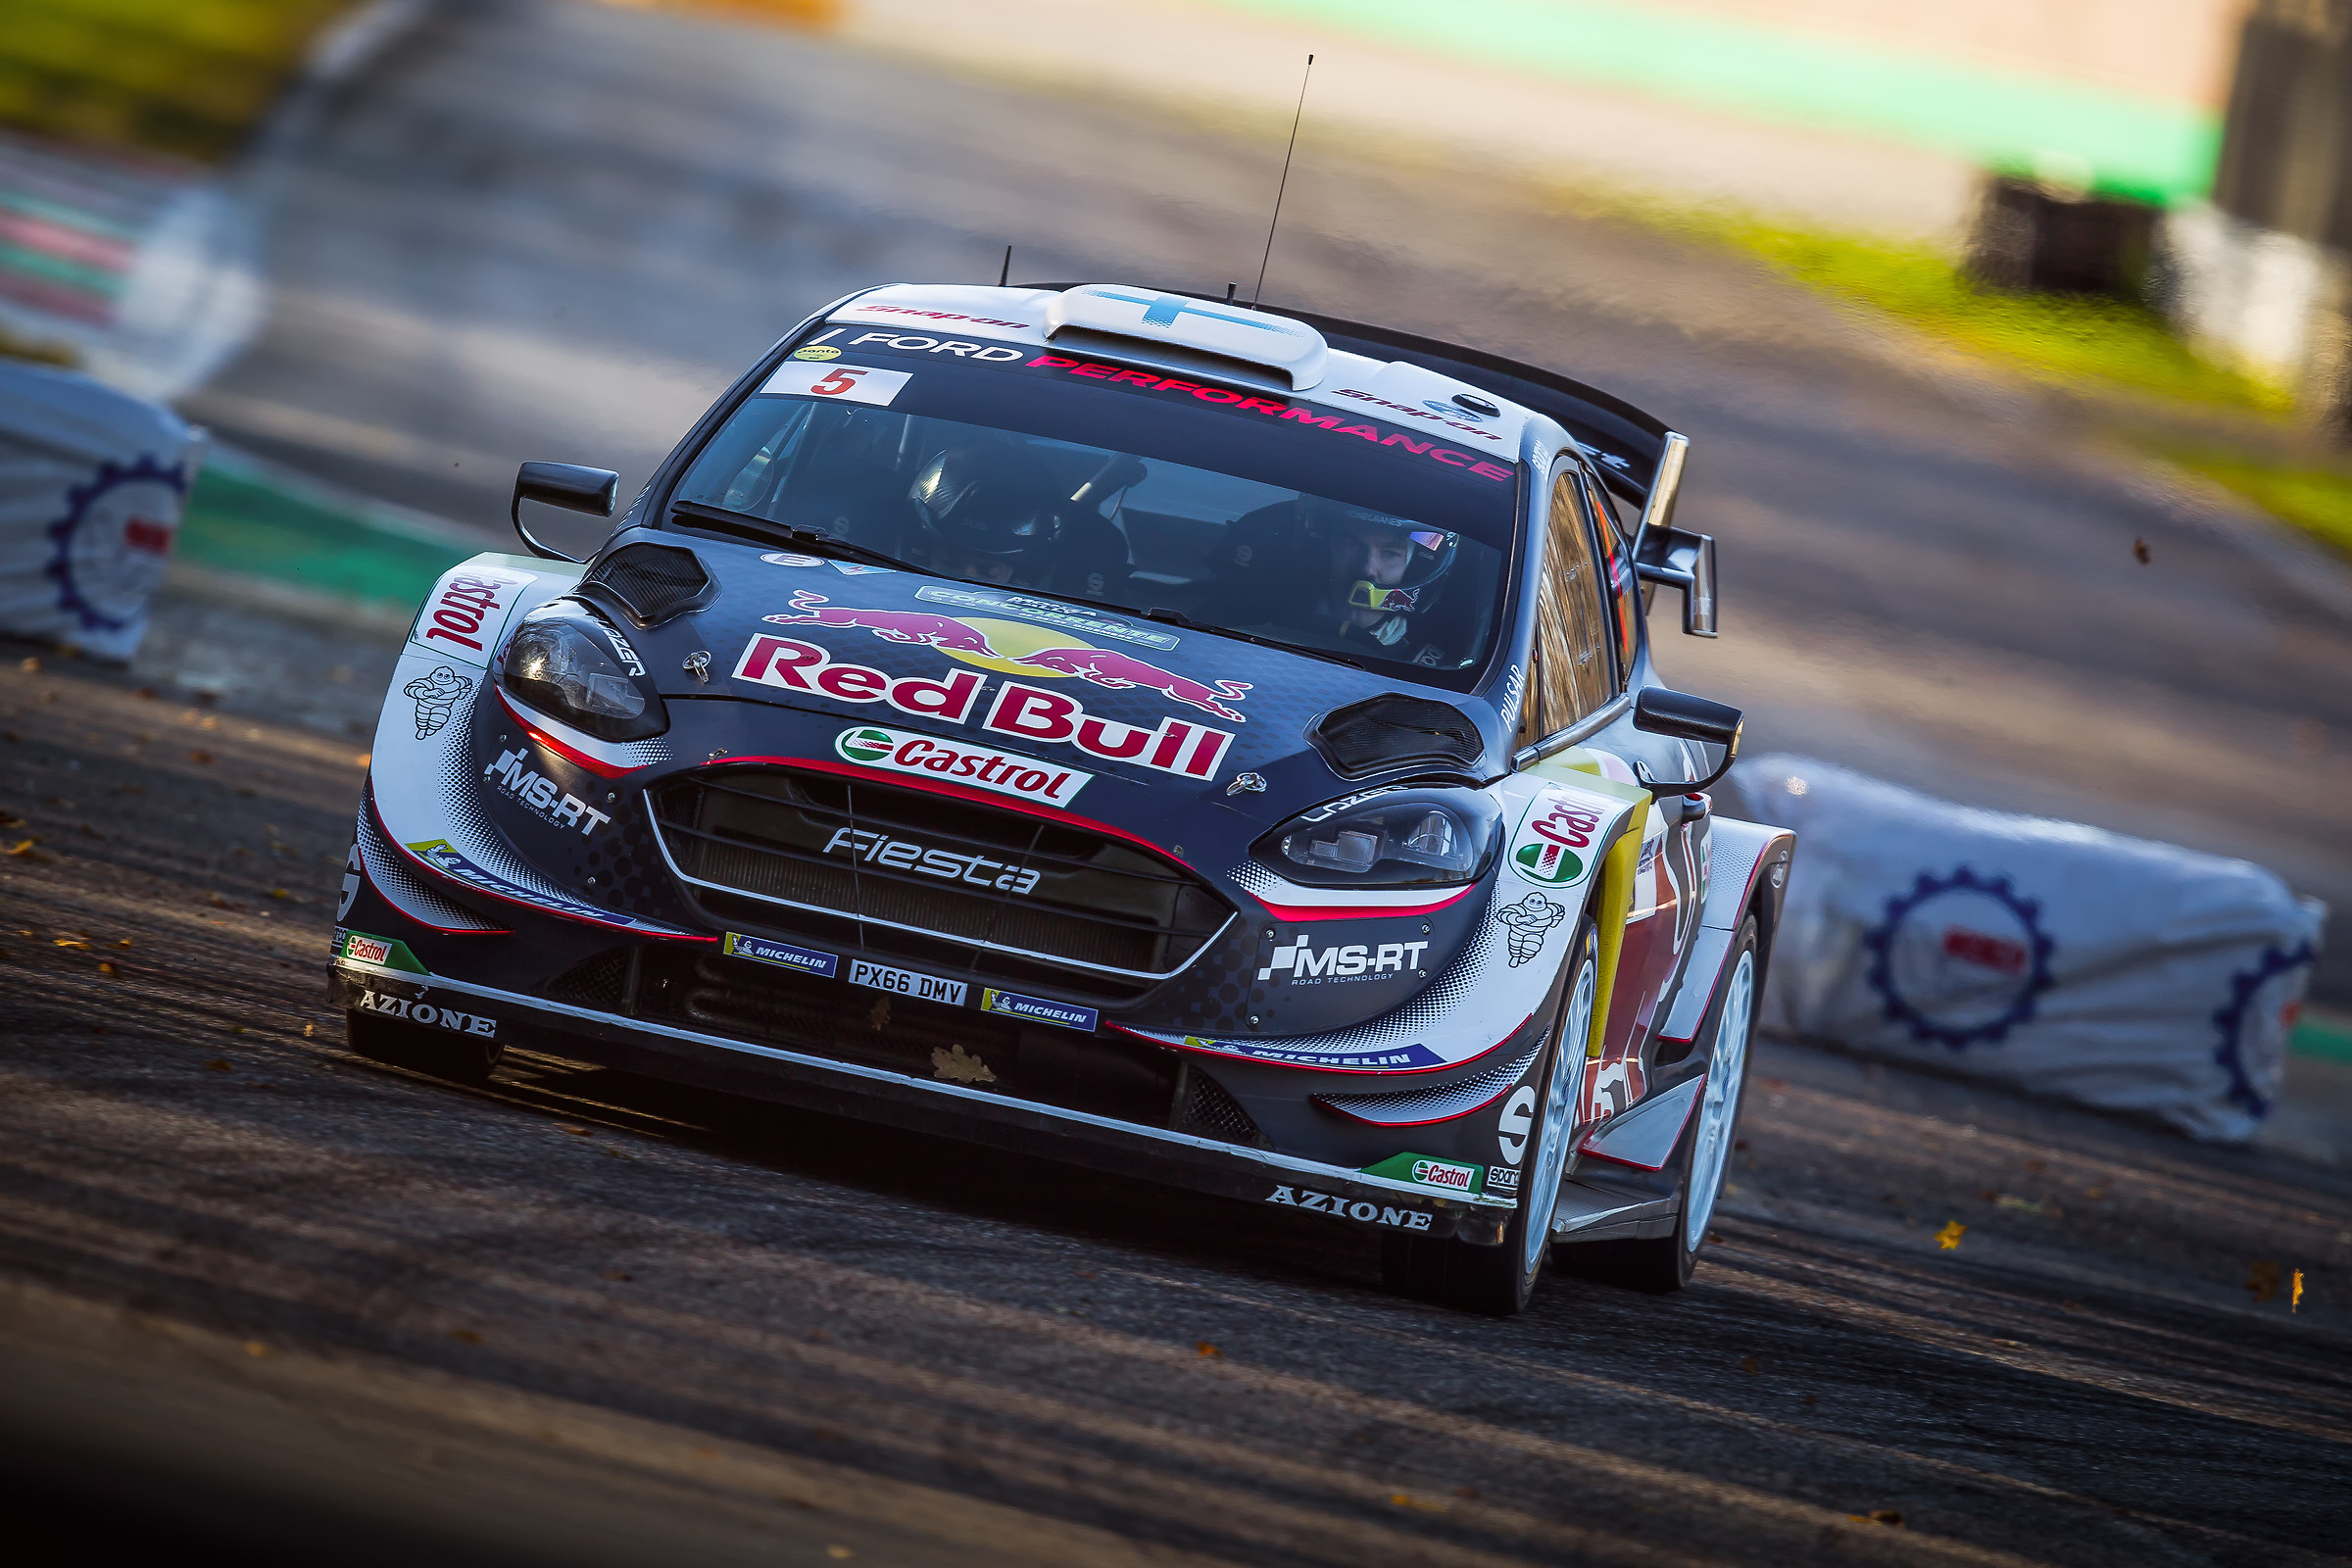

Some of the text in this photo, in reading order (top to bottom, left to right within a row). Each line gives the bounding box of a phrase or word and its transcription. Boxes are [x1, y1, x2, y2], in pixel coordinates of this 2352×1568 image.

[856, 305, 1030, 329] Snap-on
[810, 368, 868, 395] 5
[848, 332, 1024, 362] FORD
[1024, 355, 1515, 483] PERFORMANCE
[1331, 388, 1502, 441] Snap-on
[927, 590, 1170, 644] CONCORRENTE
[734, 634, 1235, 781] Red Bull
[1500, 663, 1525, 733] PULSAR
[894, 737, 1072, 799] Castrol
[497, 785, 565, 830] ROAD TECHNOLOGY
[823, 827, 1042, 895] Fiesta
[453, 866, 605, 918] MICHELIN
[354, 939, 388, 962] Castrol
[756, 946, 827, 969] MICHELIN
[854, 962, 963, 1004] PX66 DMV
[1328, 972, 1394, 984] TECHNOLOGY
[360, 989, 497, 1039] AZIONE
[1014, 1001, 1087, 1023] MICHELIN
[1252, 1049, 1410, 1065] MICHELIN
[1427, 1164, 1471, 1188] Castrol
[1265, 1184, 1433, 1231] AZIONE
